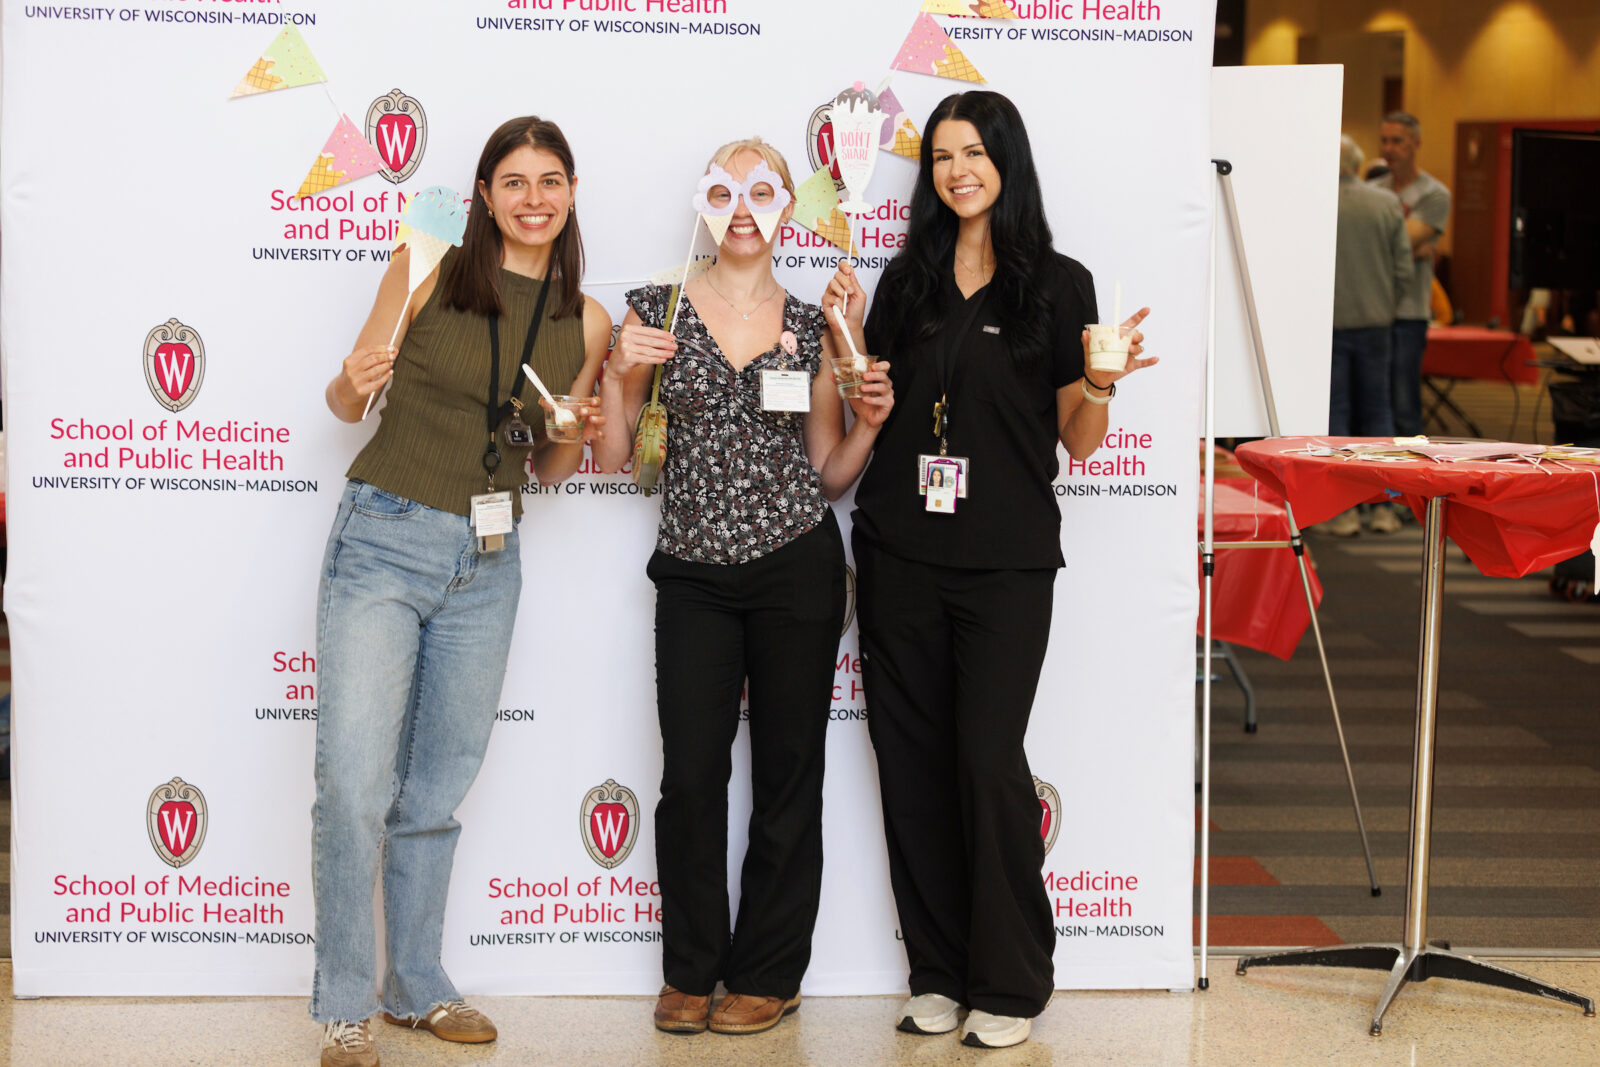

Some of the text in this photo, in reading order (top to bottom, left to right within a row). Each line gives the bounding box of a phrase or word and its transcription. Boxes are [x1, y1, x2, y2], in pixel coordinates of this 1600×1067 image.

[25, 6, 115, 20] UNIVERSITY
[119, 9, 140, 21] OF
[1083, 0, 1160, 20] Health
[476, 17, 565, 31] UNIVERSITY
[569, 19, 589, 32] OF
[942, 27, 1003, 40] VERSITY
[1007, 28, 1028, 40] OF
[363, 192, 388, 212] of
[284, 218, 399, 241] and Publi
[252, 247, 342, 261] UNIVERSITY
[345, 249, 367, 262] OF
[785, 255, 806, 268] OF
[51, 418, 289, 443] School of Medicine
[64, 447, 283, 471] and Public Health
[1069, 455, 1145, 476] Health
[32, 476, 121, 489] UNIVERSITY
[125, 477, 146, 490] OF
[565, 482, 586, 495] OF
[1052, 484, 1177, 496] ONSIN–MADISON
[273, 651, 315, 672] Sch
[286, 685, 314, 700] an
[255, 708, 318, 720] UNIVERS
[54, 874, 290, 897] School of Medicine
[489, 876, 567, 898] School
[577, 877, 600, 896] of
[66, 902, 283, 924] and Public Health
[501, 904, 544, 925] and
[554, 903, 624, 923] Public
[1056, 897, 1131, 917] Health
[34, 931, 122, 943] UNIVERSITY
[126, 931, 147, 943] OF
[470, 932, 556, 946] UNIVERSITY
[559, 931, 579, 943] OF
[1055, 925, 1164, 937] NSIN–MADISON
